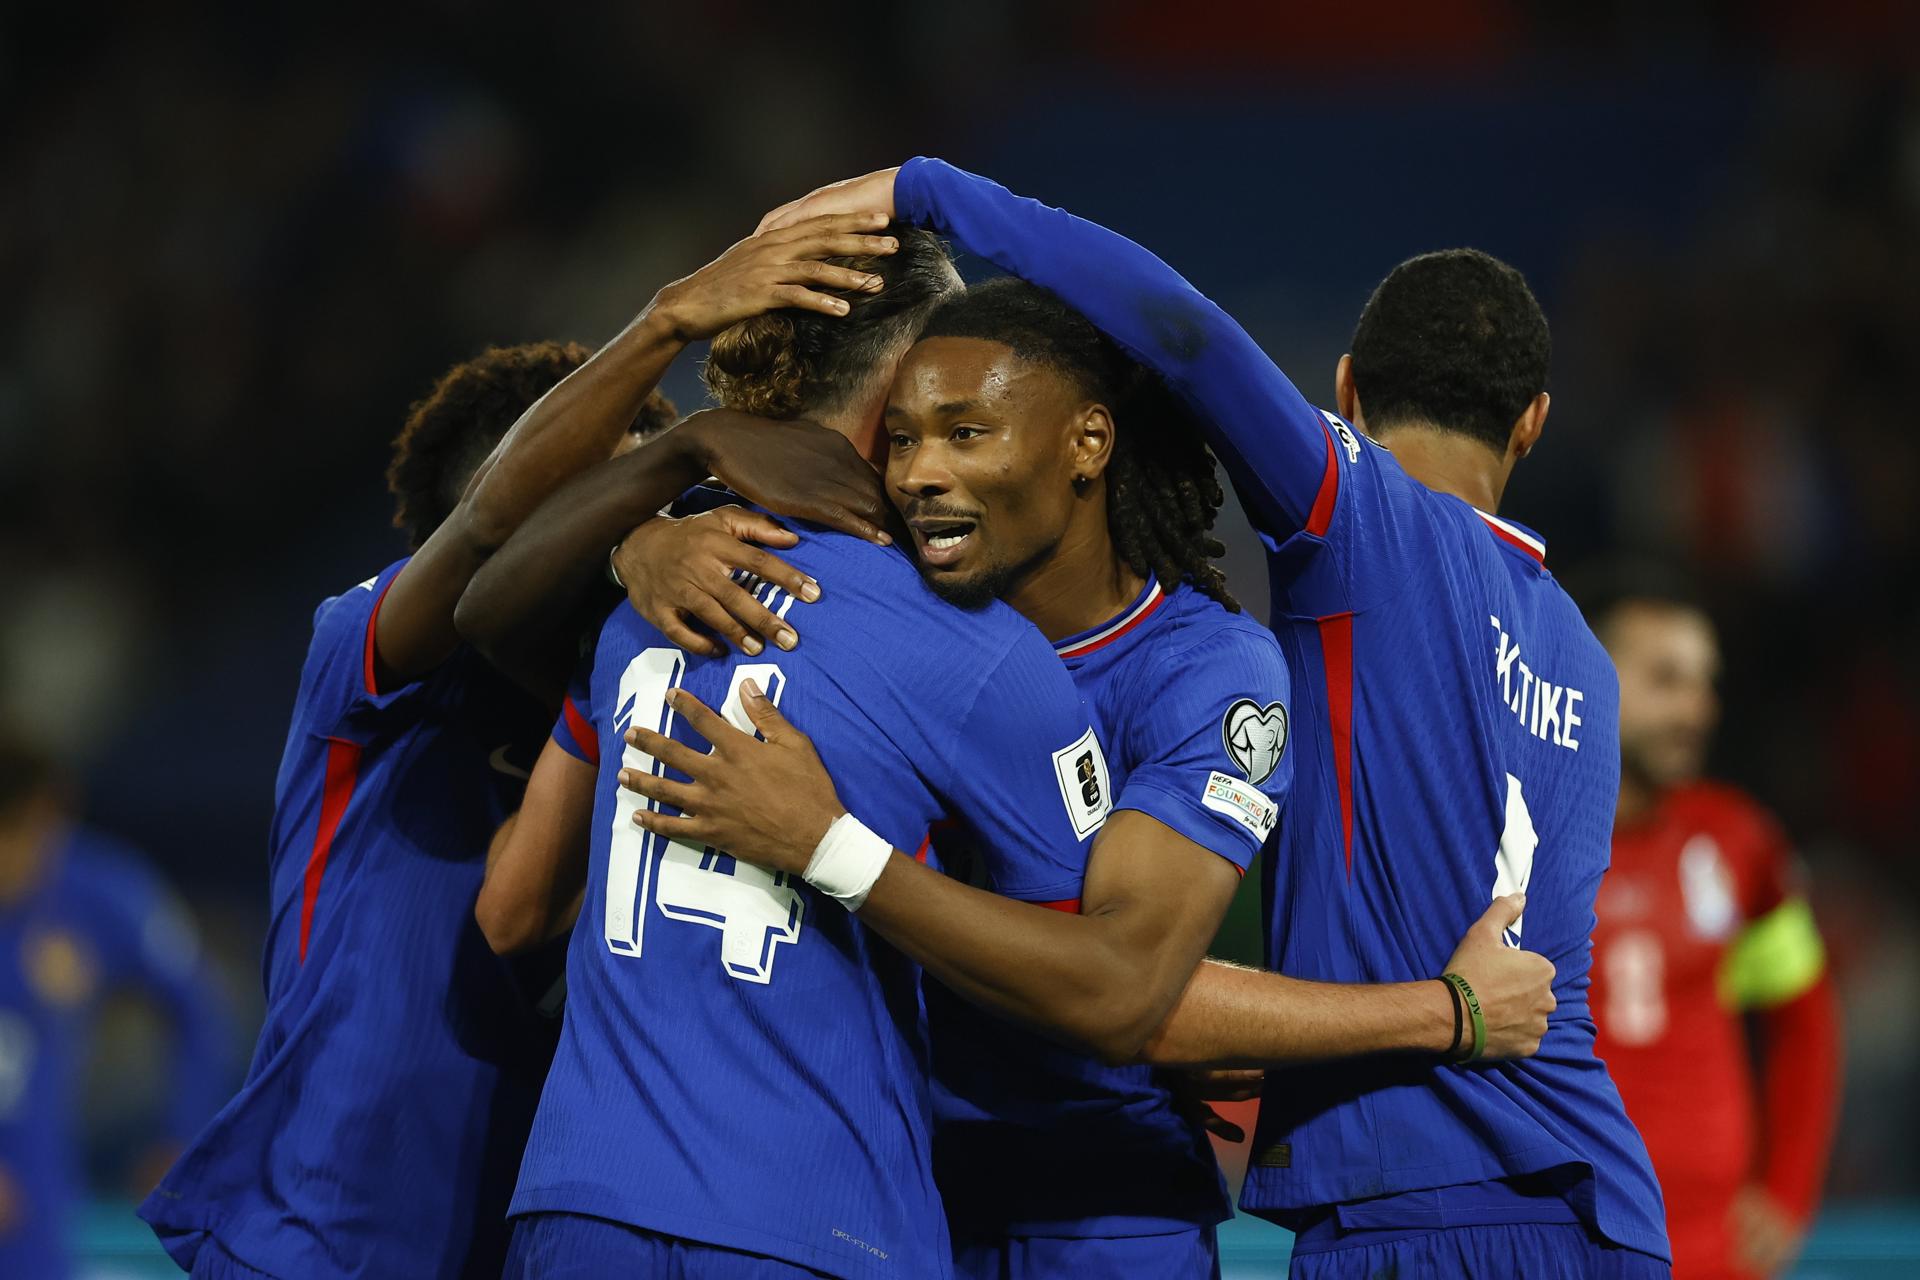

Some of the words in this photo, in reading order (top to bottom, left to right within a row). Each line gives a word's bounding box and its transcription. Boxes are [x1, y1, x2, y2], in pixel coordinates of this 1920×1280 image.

[1490, 615, 1583, 752] KTIKE
[1212, 774, 1232, 786] UEFA
[605, 647, 804, 984] 14
[1208, 785, 1261, 817] FOUNDATIO
[1470, 999, 1482, 1015] AC
